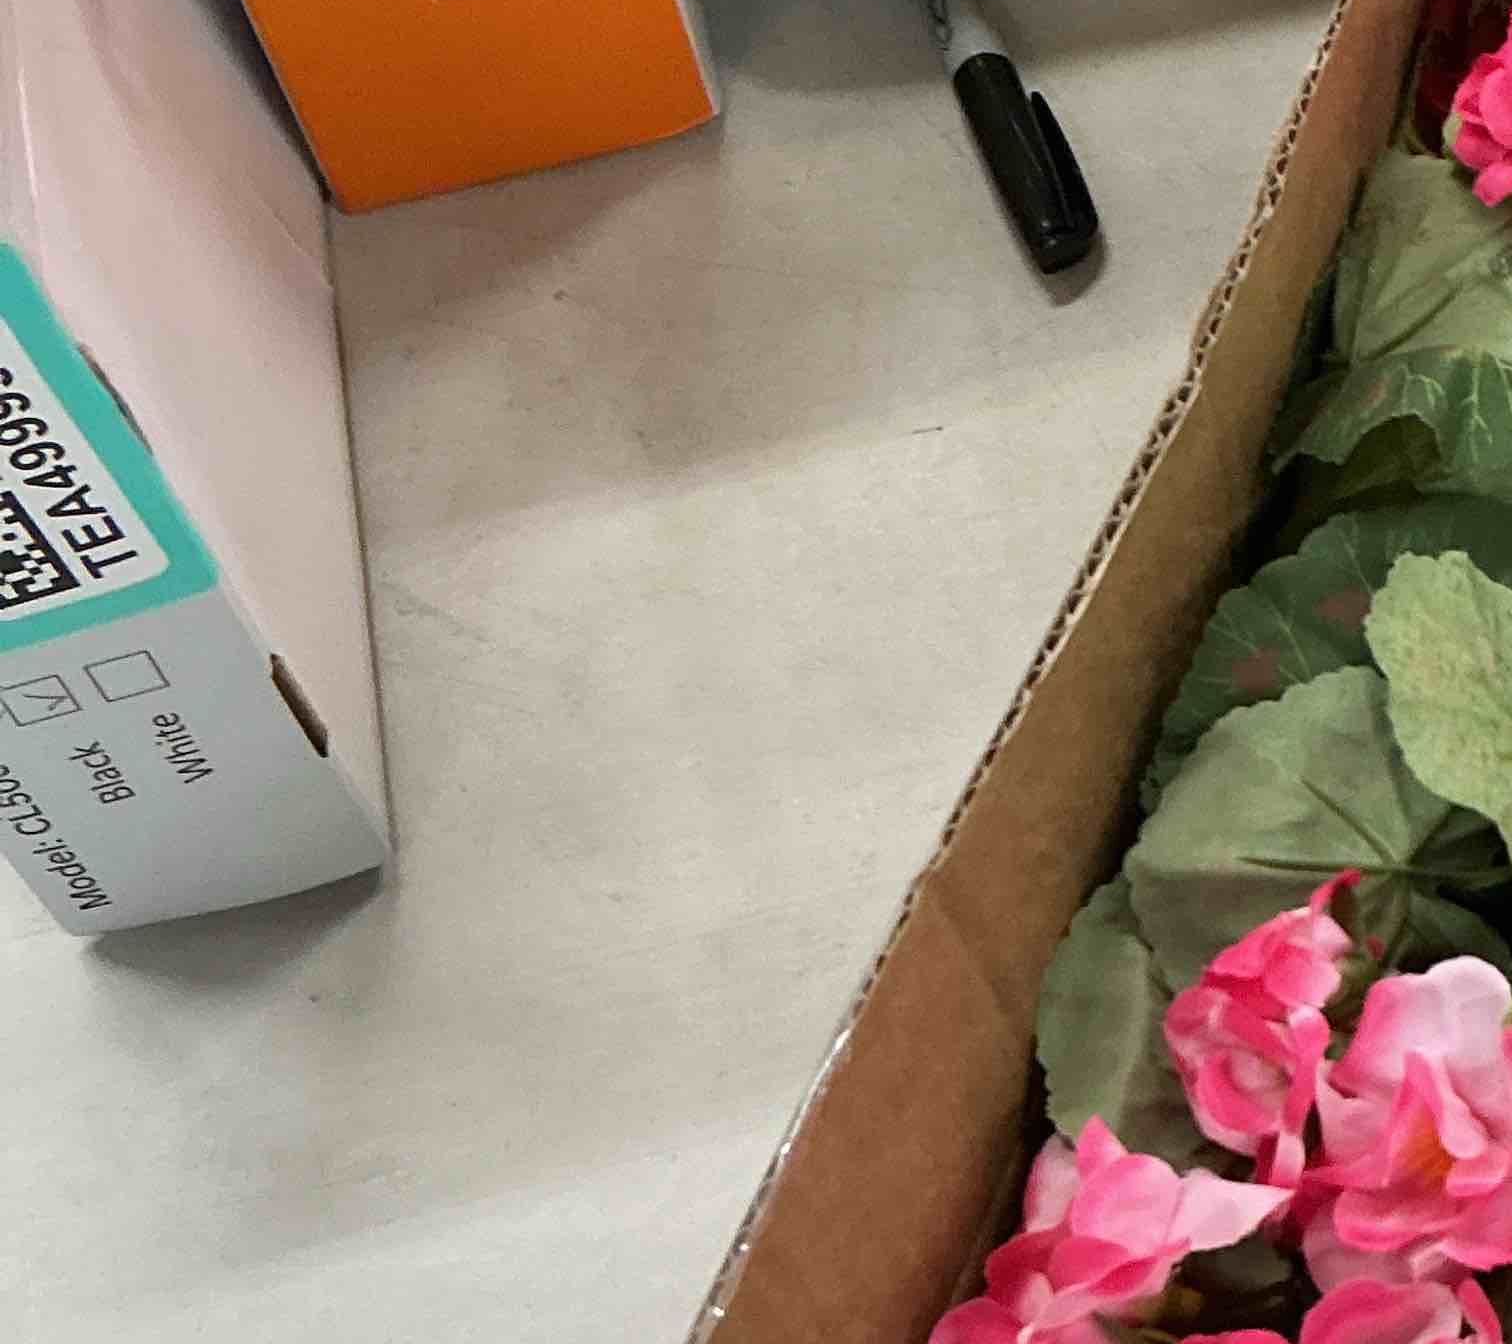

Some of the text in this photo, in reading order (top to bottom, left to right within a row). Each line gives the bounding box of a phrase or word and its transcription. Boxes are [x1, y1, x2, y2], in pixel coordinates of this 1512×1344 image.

[69, 740, 137, 805] Black
[152, 711, 214, 785] White
[33, 837, 113, 911] Model:
